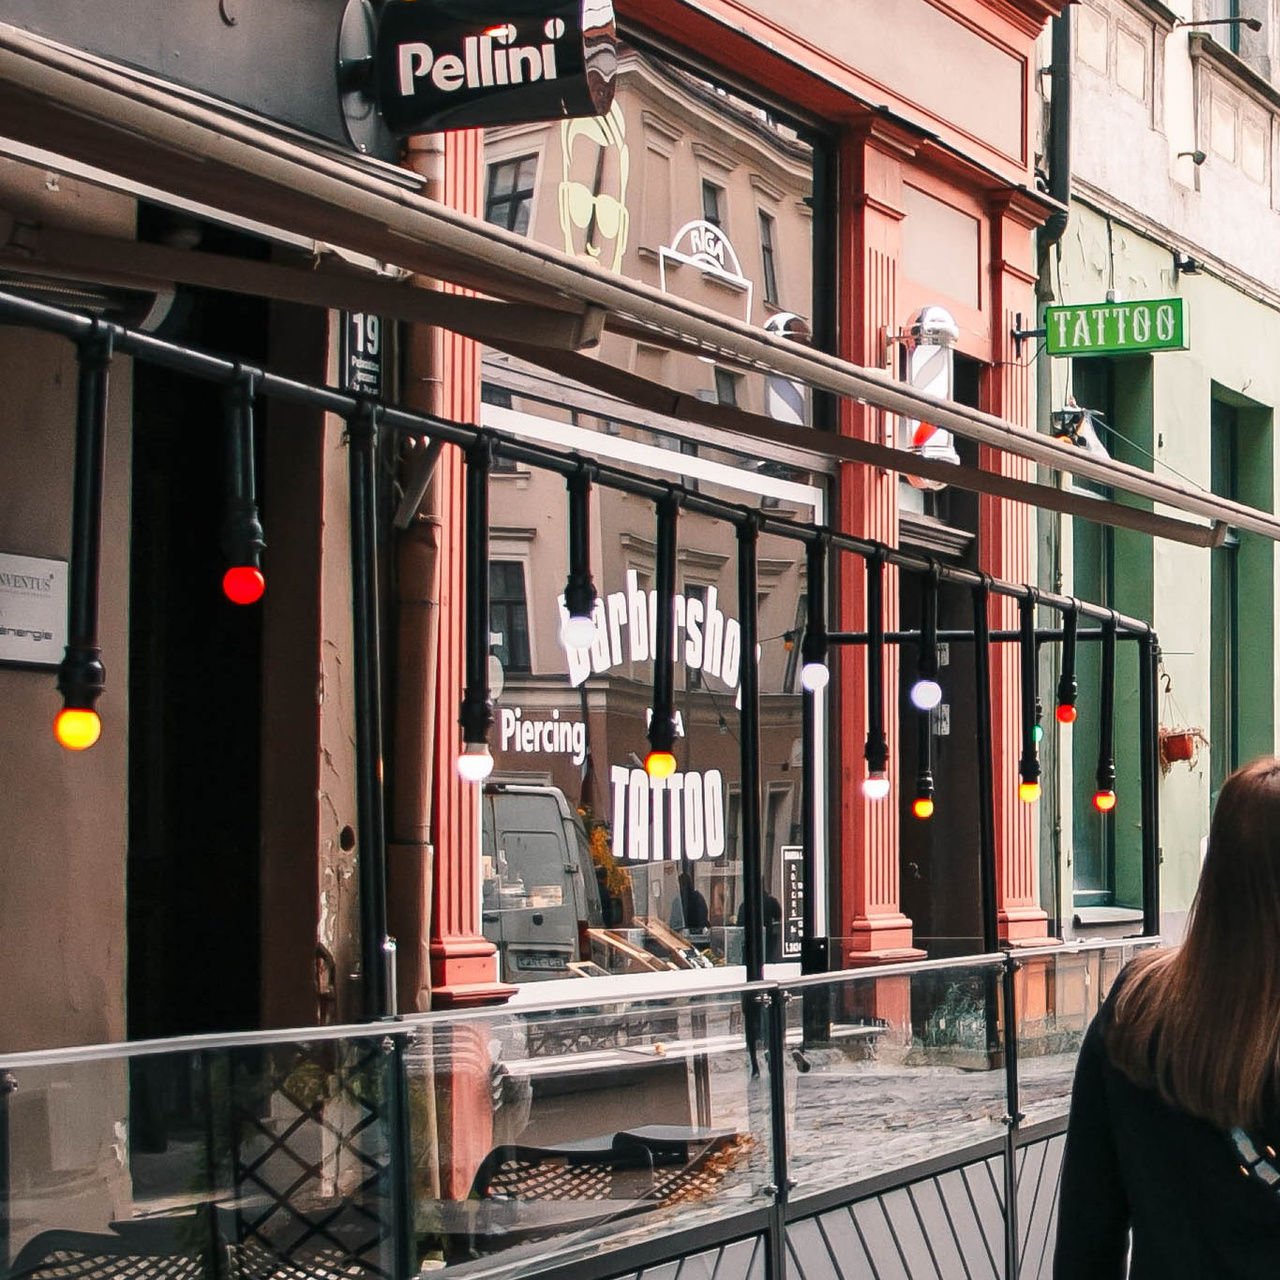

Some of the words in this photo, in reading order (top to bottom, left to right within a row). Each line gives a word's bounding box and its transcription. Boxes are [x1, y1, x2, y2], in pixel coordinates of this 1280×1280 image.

[399, 18, 565, 96] Pellini
[690, 226, 725, 266] RIGA
[353, 312, 379, 355] 19
[1053, 304, 1175, 348] TATTOO
[501, 707, 586, 766] Piercing
[611, 764, 725, 860] TATTOO
